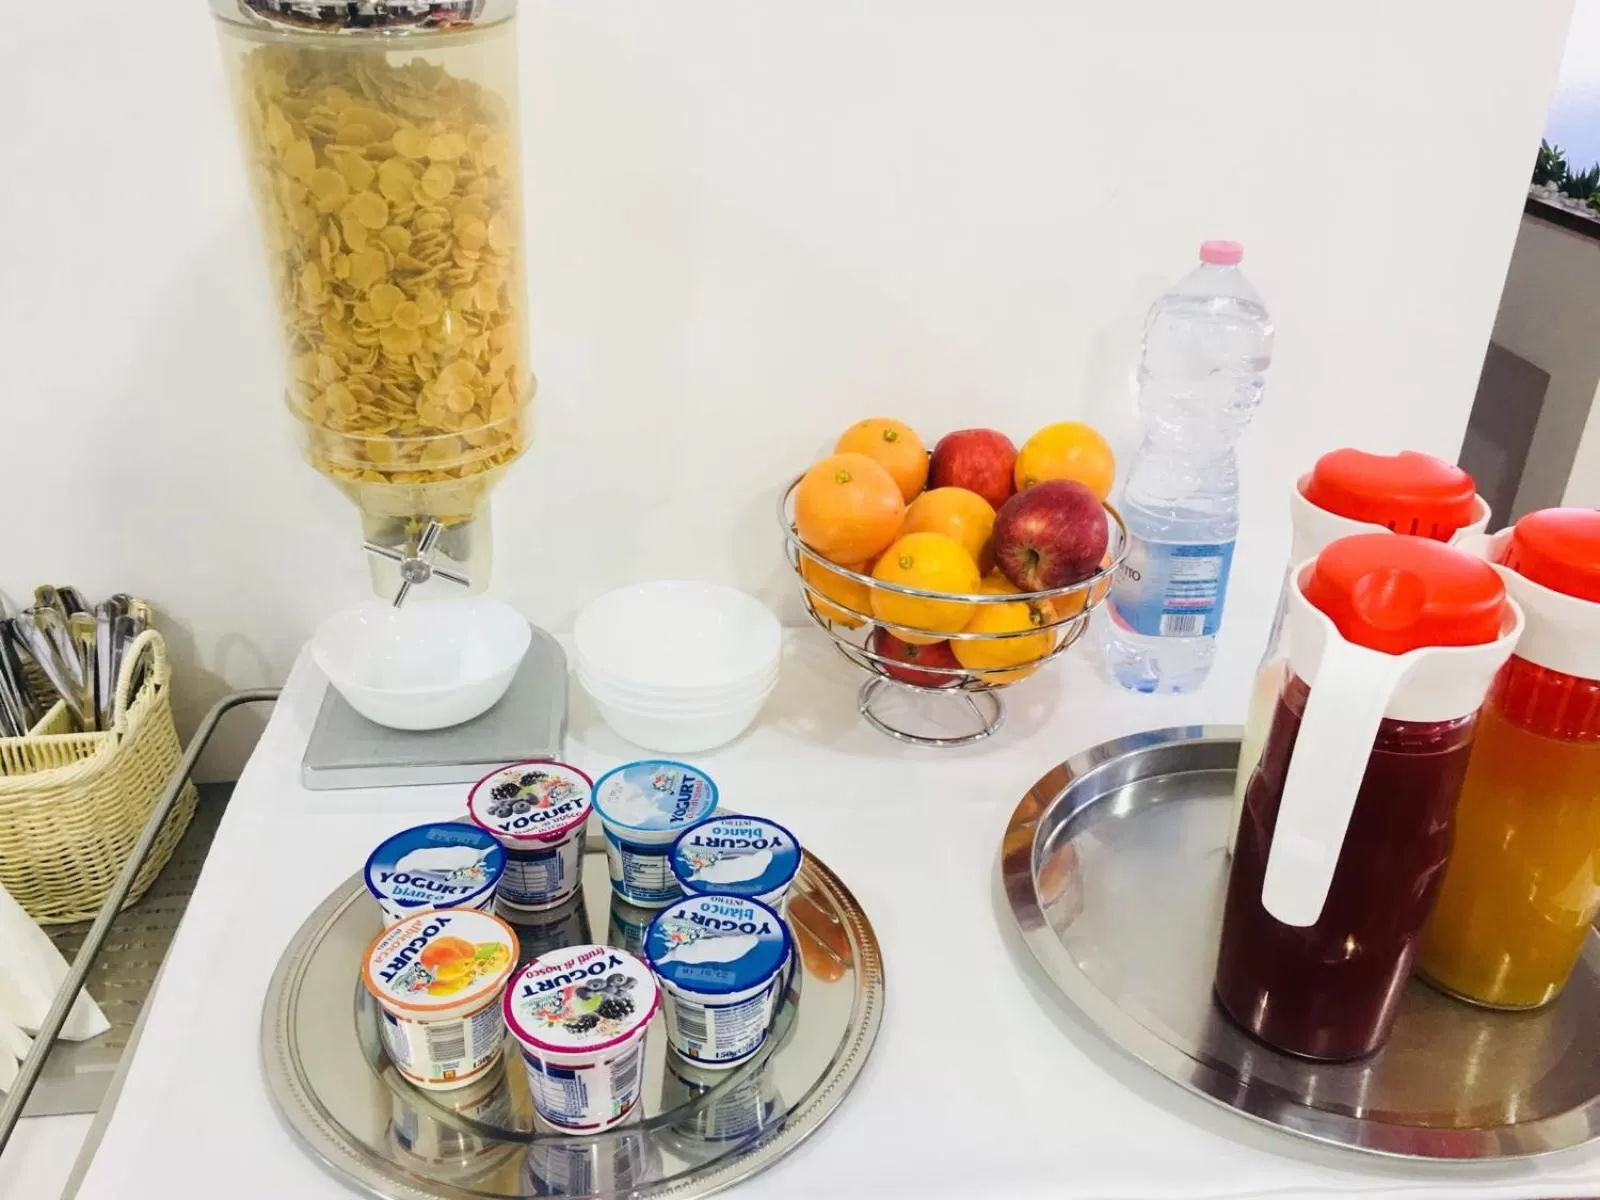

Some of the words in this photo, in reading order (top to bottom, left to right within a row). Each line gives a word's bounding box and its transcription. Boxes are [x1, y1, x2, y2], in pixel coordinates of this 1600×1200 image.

[670, 774, 696, 824] YOGURT
[498, 797, 584, 832] YOGURT
[712, 826, 763, 838] bianco
[690, 835, 783, 850] YOGURT
[380, 872, 475, 894] YOGURT
[392, 885, 445, 901] bianco
[700, 902, 754, 920] bianco
[672, 910, 772, 935] YOGURT
[374, 919, 424, 963] albicocca
[379, 917, 452, 984] YOGURT
[564, 959, 575, 970] di
[577, 947, 606, 966] frutti
[522, 955, 624, 998] YOGURT
[526, 965, 562, 979] bosco
